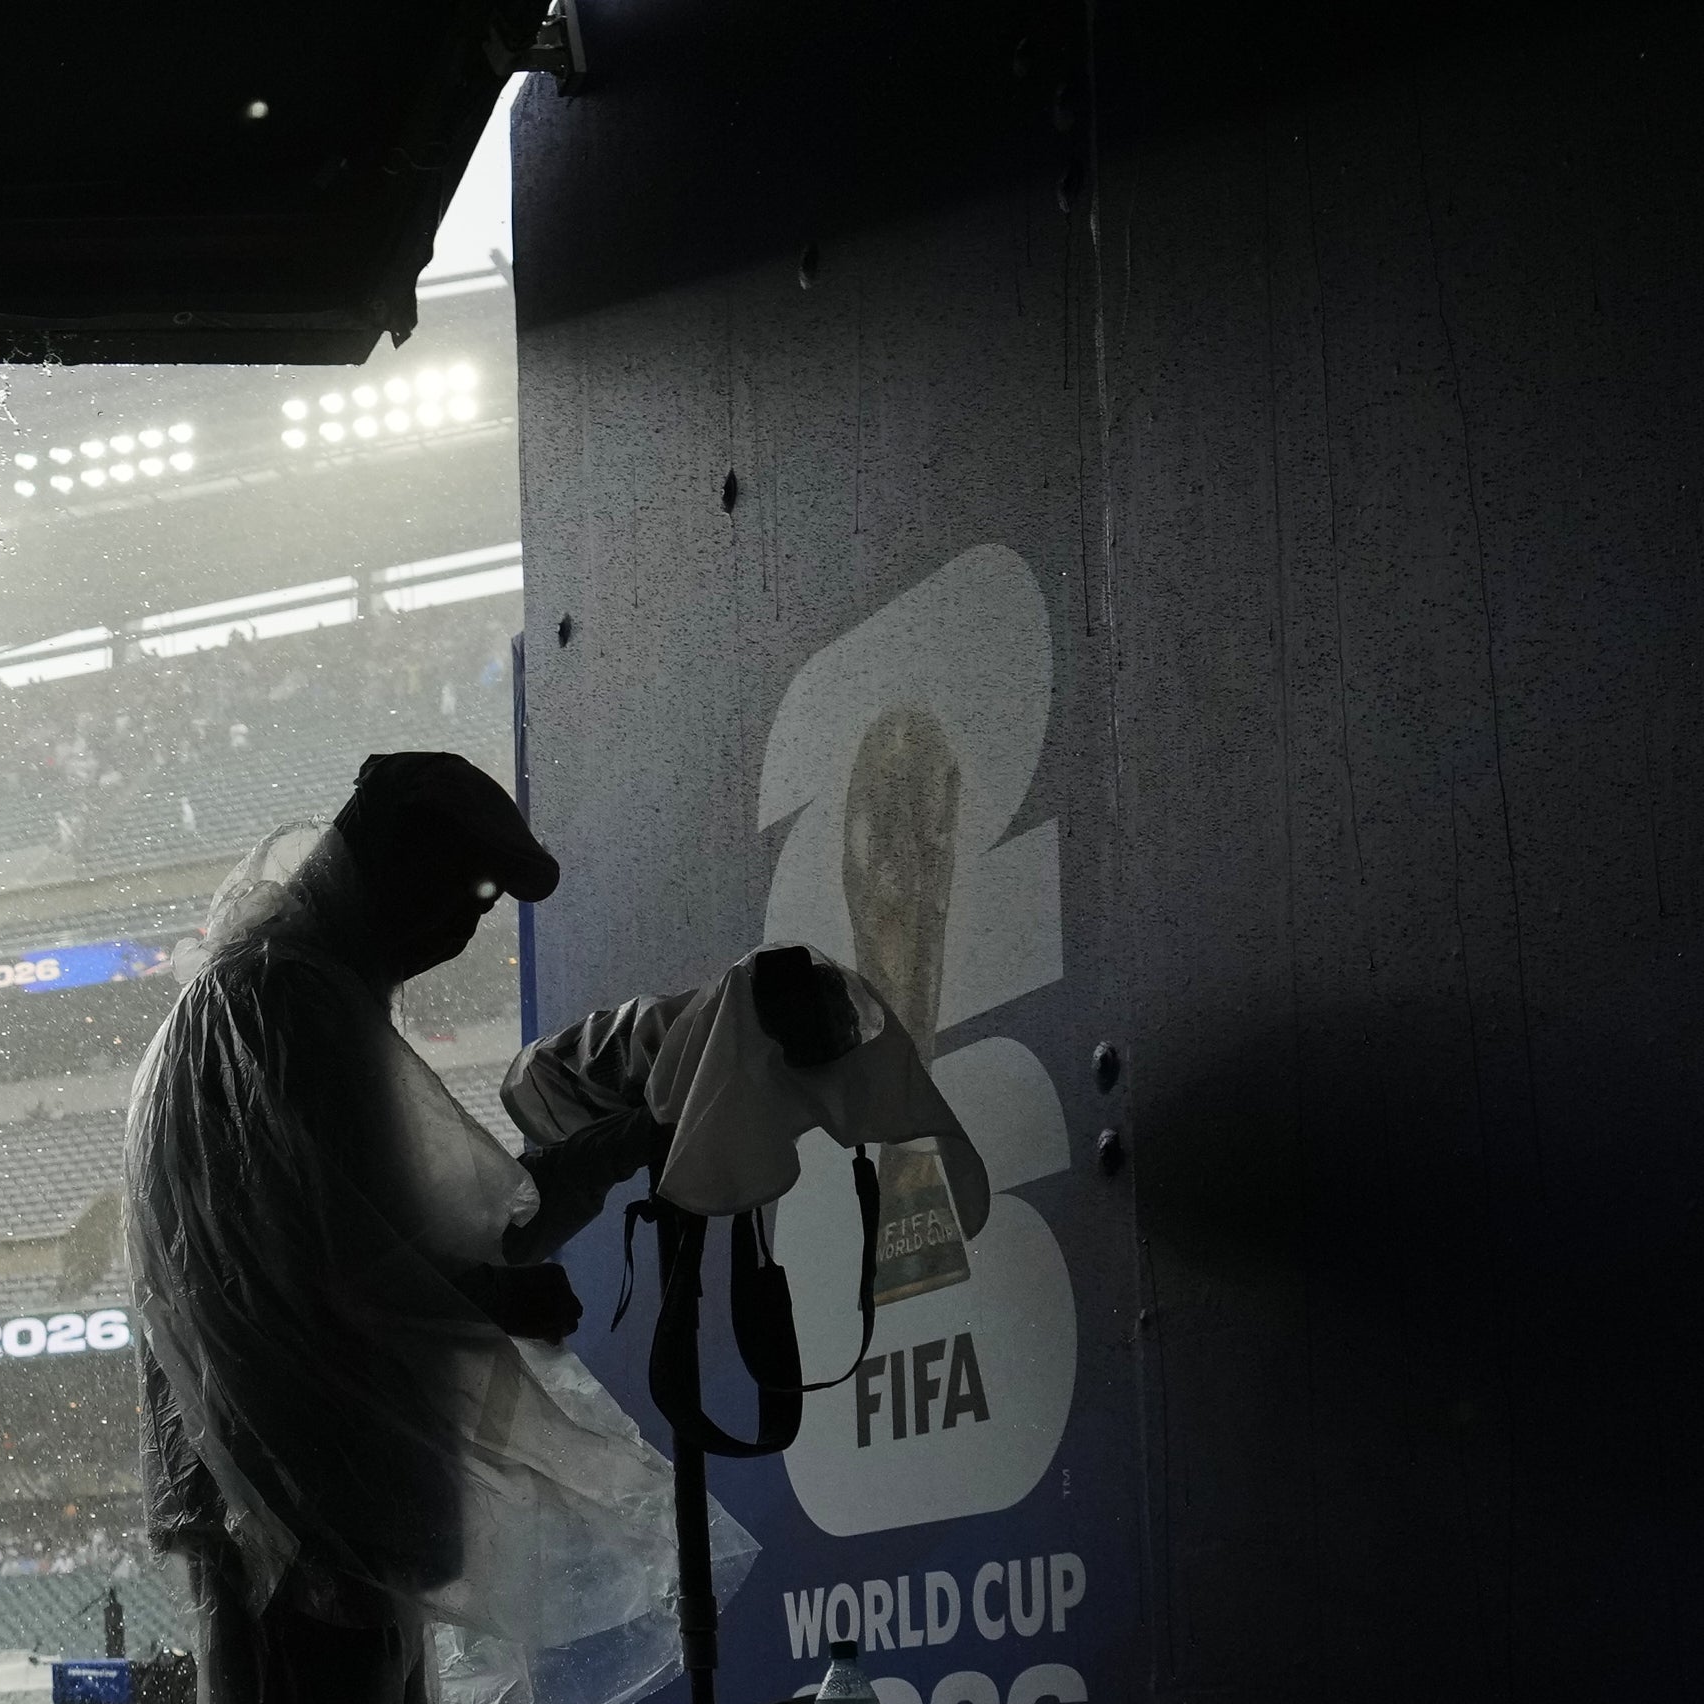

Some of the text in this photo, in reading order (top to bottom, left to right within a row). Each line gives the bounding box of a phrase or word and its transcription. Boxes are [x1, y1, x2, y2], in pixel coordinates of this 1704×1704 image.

[884, 1209, 941, 1241] FIFA
[927, 1221, 954, 1246] CUP
[855, 1331, 991, 1449] FIFA
[783, 1552, 1087, 1659] WORLD CUP
